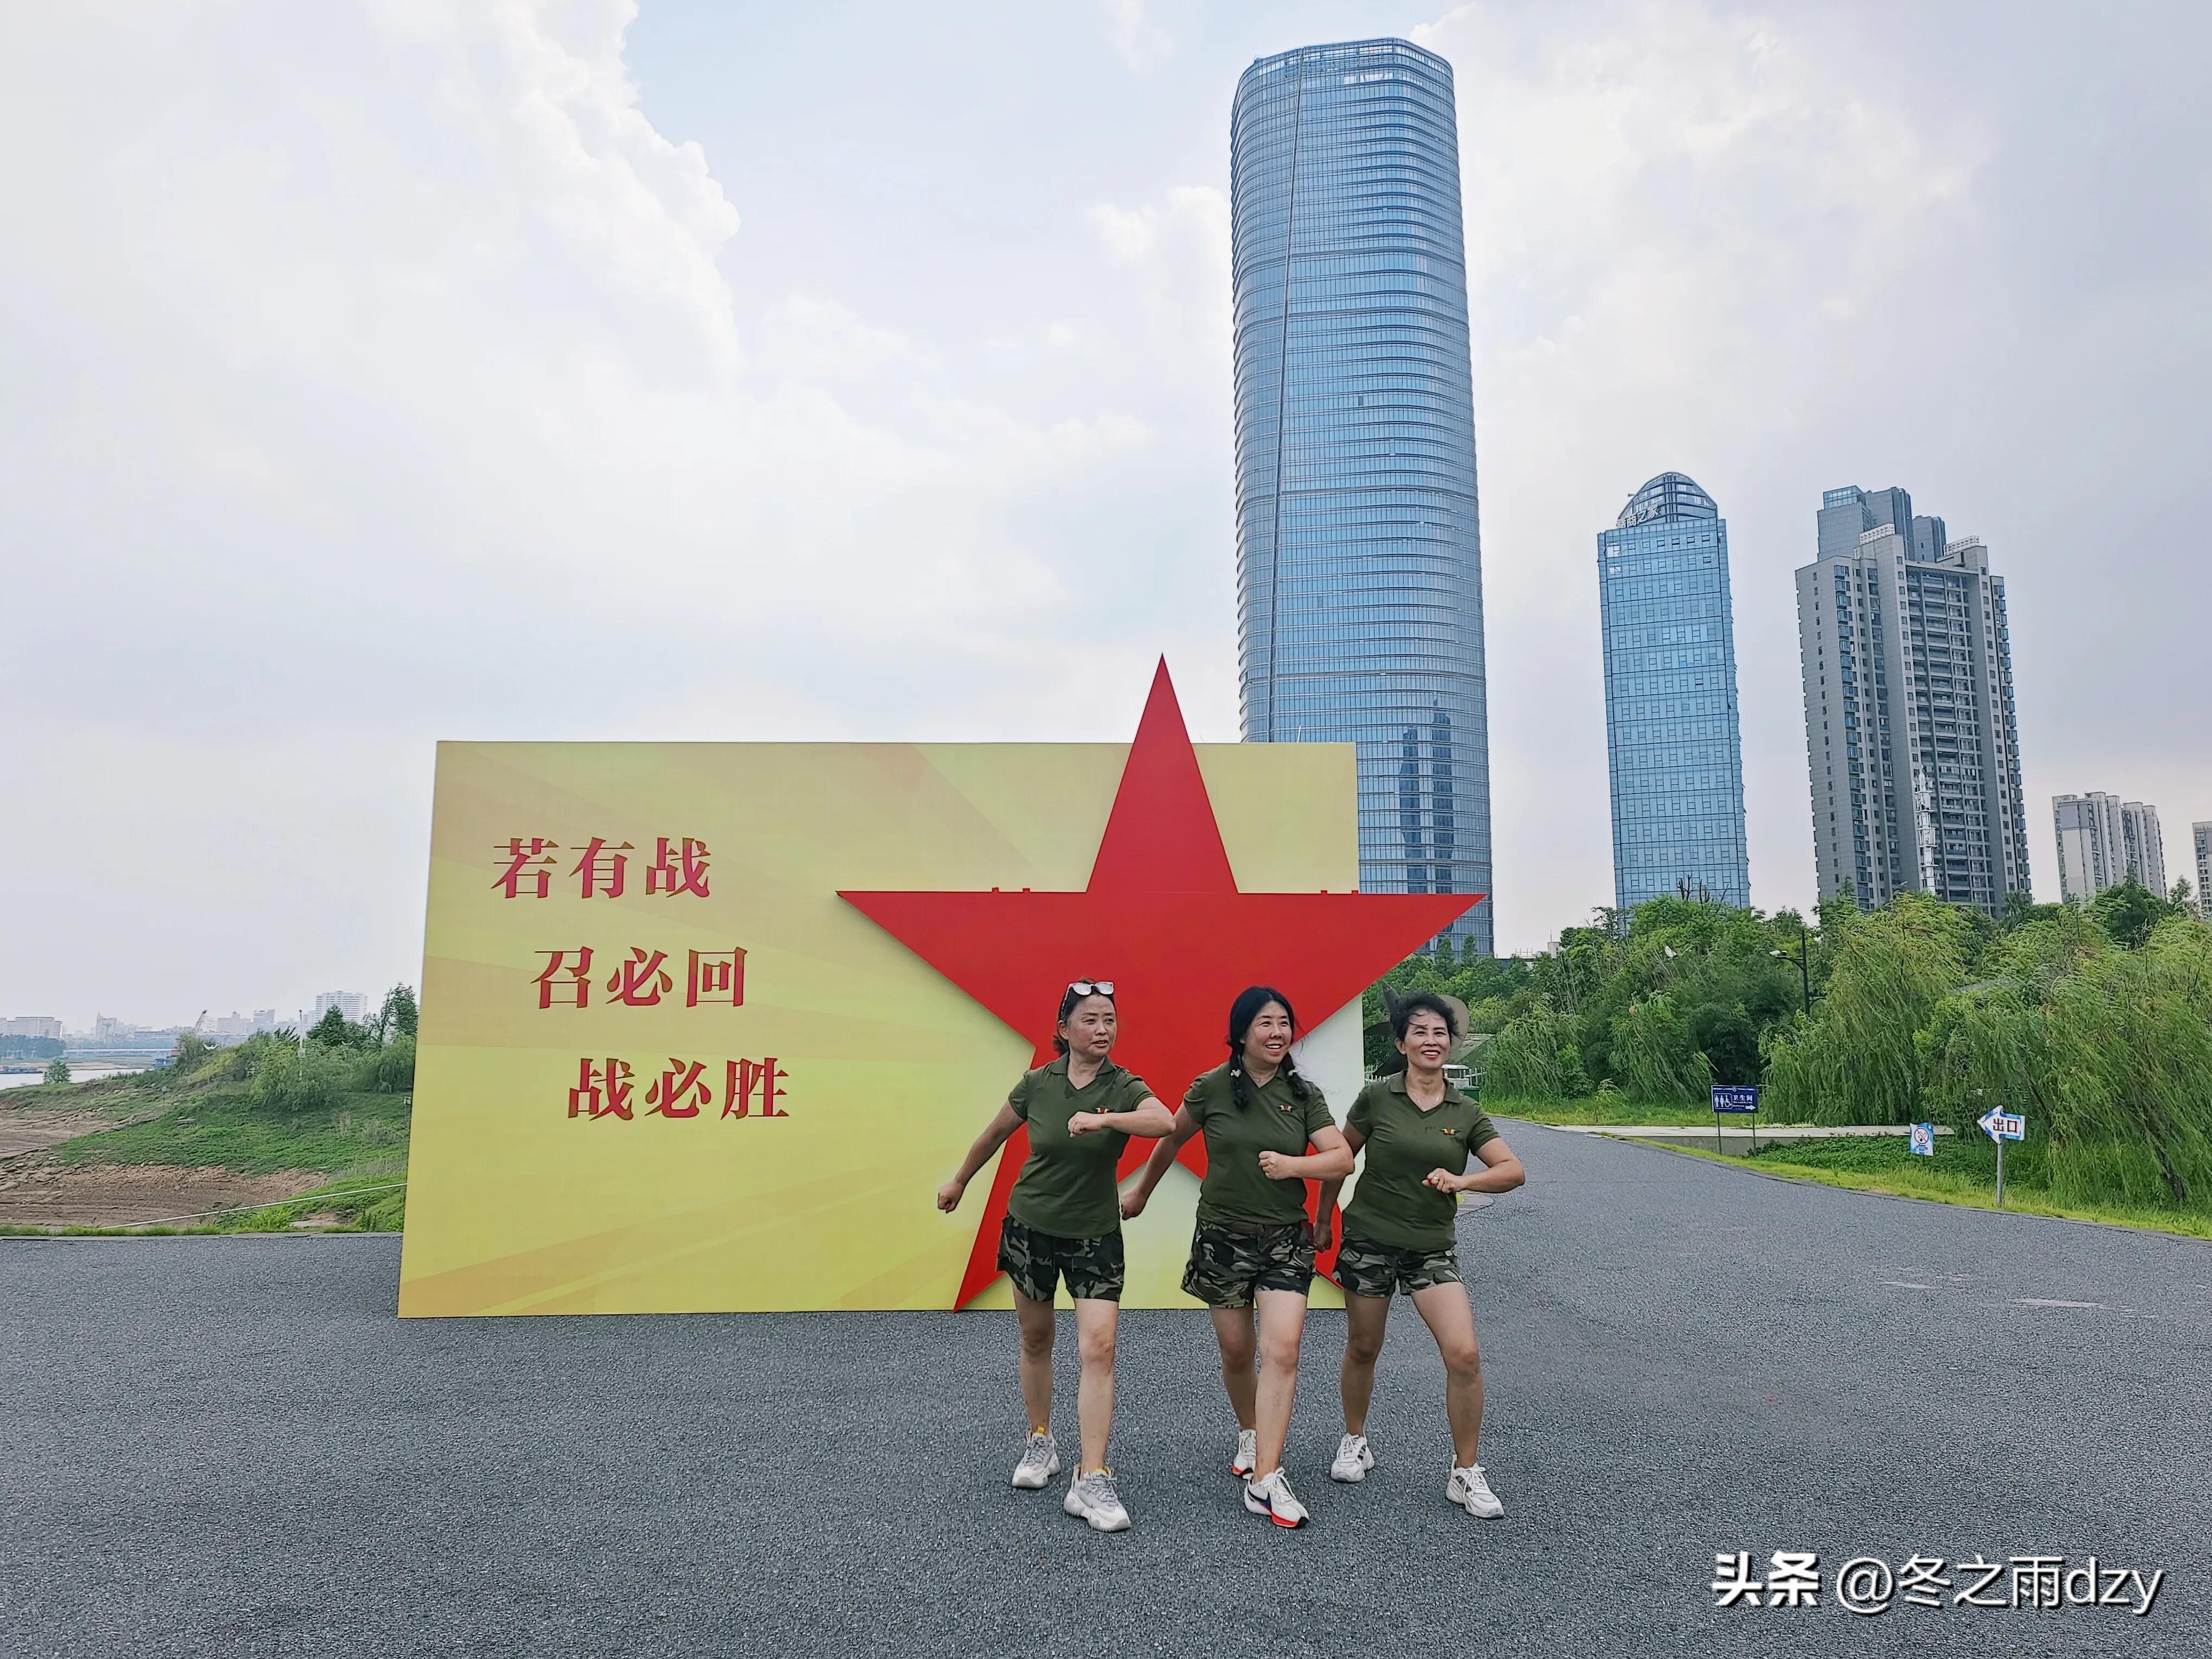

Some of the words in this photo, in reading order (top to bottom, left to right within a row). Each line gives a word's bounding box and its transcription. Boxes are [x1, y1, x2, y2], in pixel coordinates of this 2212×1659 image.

[491, 837, 711, 899] 若有战
[531, 946, 748, 1009] 召必回
[567, 1057, 789, 1121] 战必胜
[1993, 1118, 2017, 1133] 出口
